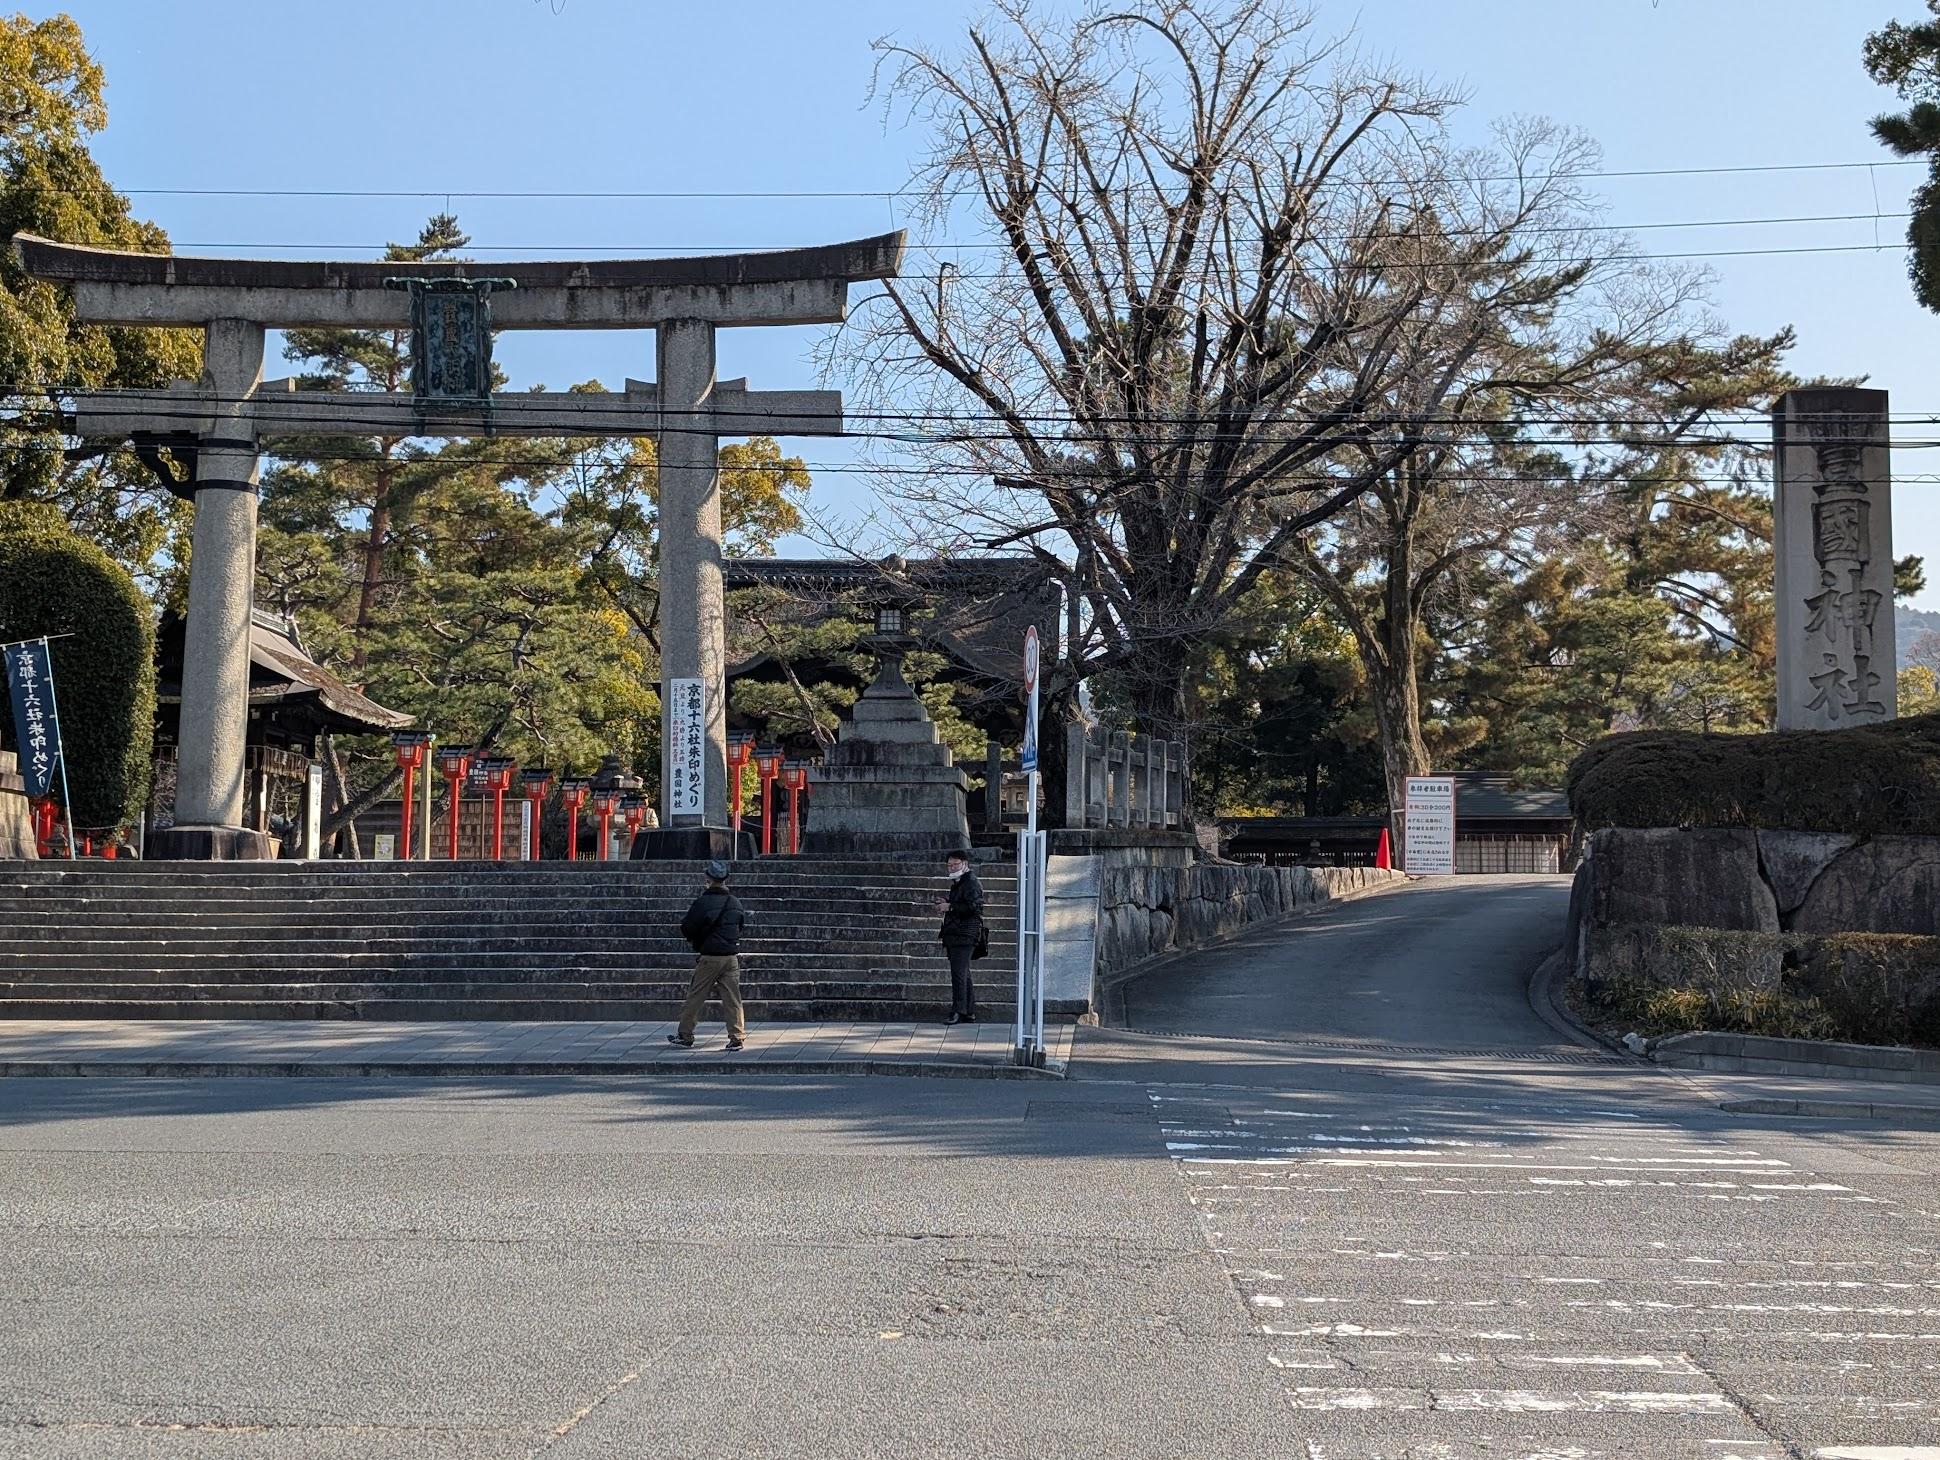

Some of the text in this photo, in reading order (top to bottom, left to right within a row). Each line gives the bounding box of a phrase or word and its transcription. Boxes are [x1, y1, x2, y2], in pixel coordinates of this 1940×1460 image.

[686, 683, 702, 808] 京都十六社朱印めぐり
[673, 767, 683, 808] 豊国神社
